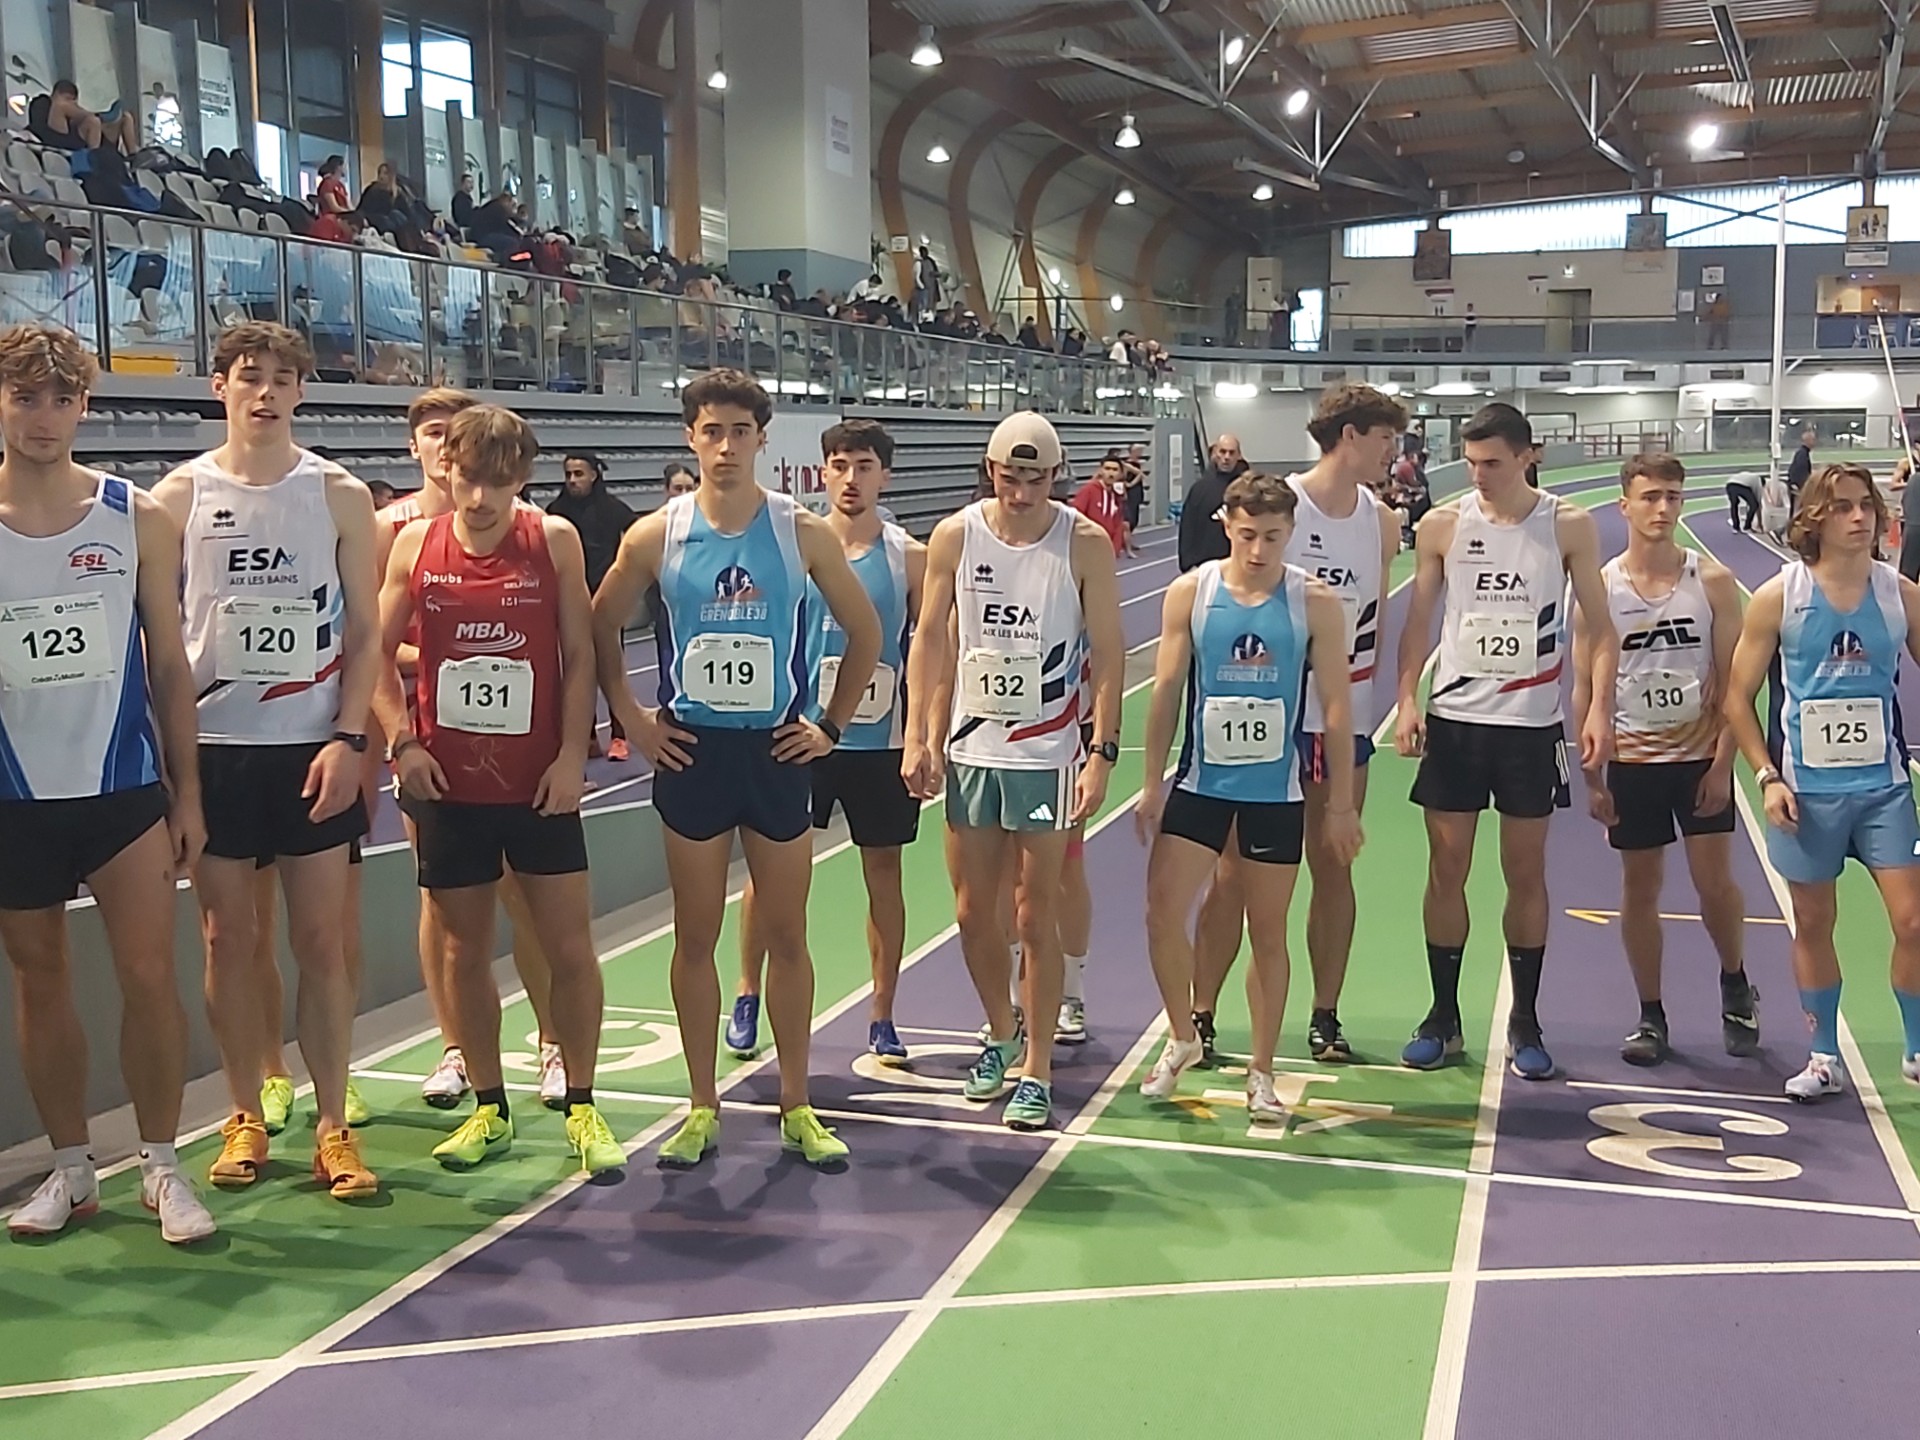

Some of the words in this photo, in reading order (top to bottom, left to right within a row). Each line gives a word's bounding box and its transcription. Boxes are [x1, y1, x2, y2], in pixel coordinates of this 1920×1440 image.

[70, 554, 108, 567] ESL
[228, 547, 298, 571] ESA
[229, 577, 245, 586] AIX
[248, 576, 264, 585] LES
[267, 575, 298, 584] BAINS
[423, 570, 463, 588] Doubs
[1316, 567, 1360, 587] ESA
[1476, 572, 1529, 591] ESA
[982, 604, 1040, 626] ESA
[239, 626, 295, 653] 120
[455, 622, 506, 639] MBA
[982, 628, 996, 637] AIX
[998, 629, 1012, 638] LES
[1014, 630, 1039, 641] BAINS
[1621, 617, 1701, 651] CAL
[22, 626, 86, 659] 123
[1476, 636, 1520, 657] 129
[703, 660, 754, 685] 119
[459, 681, 509, 708] 131
[979, 673, 1024, 697] 132
[1641, 687, 1684, 709] 130
[1221, 720, 1267, 742] 118
[1820, 722, 1868, 744] 125
[1587, 1103, 1803, 1182] 3
